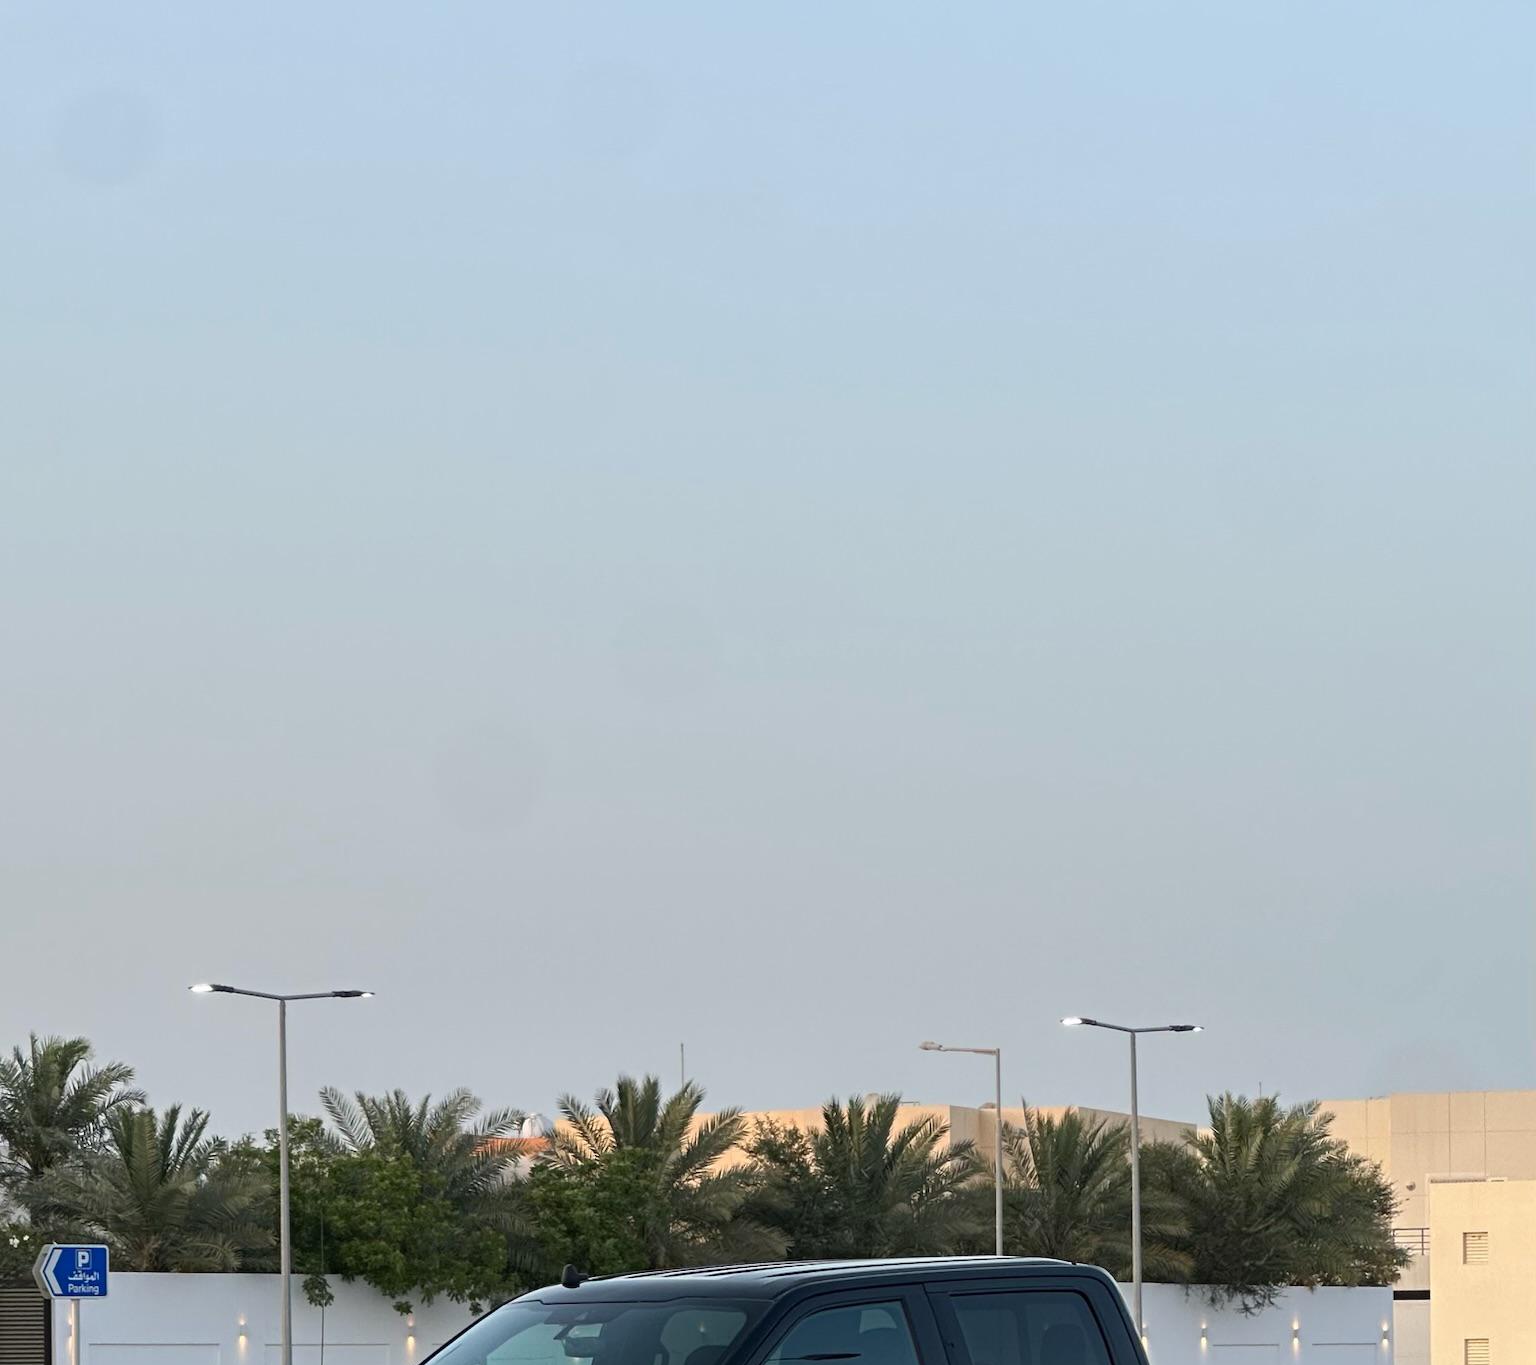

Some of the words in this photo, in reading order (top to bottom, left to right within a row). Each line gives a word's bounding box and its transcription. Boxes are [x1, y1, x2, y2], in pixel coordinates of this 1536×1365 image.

[77, 1251, 90, 1267] P
[68, 1270, 99, 1283] المواقف
[68, 1284, 99, 1295] Parking
